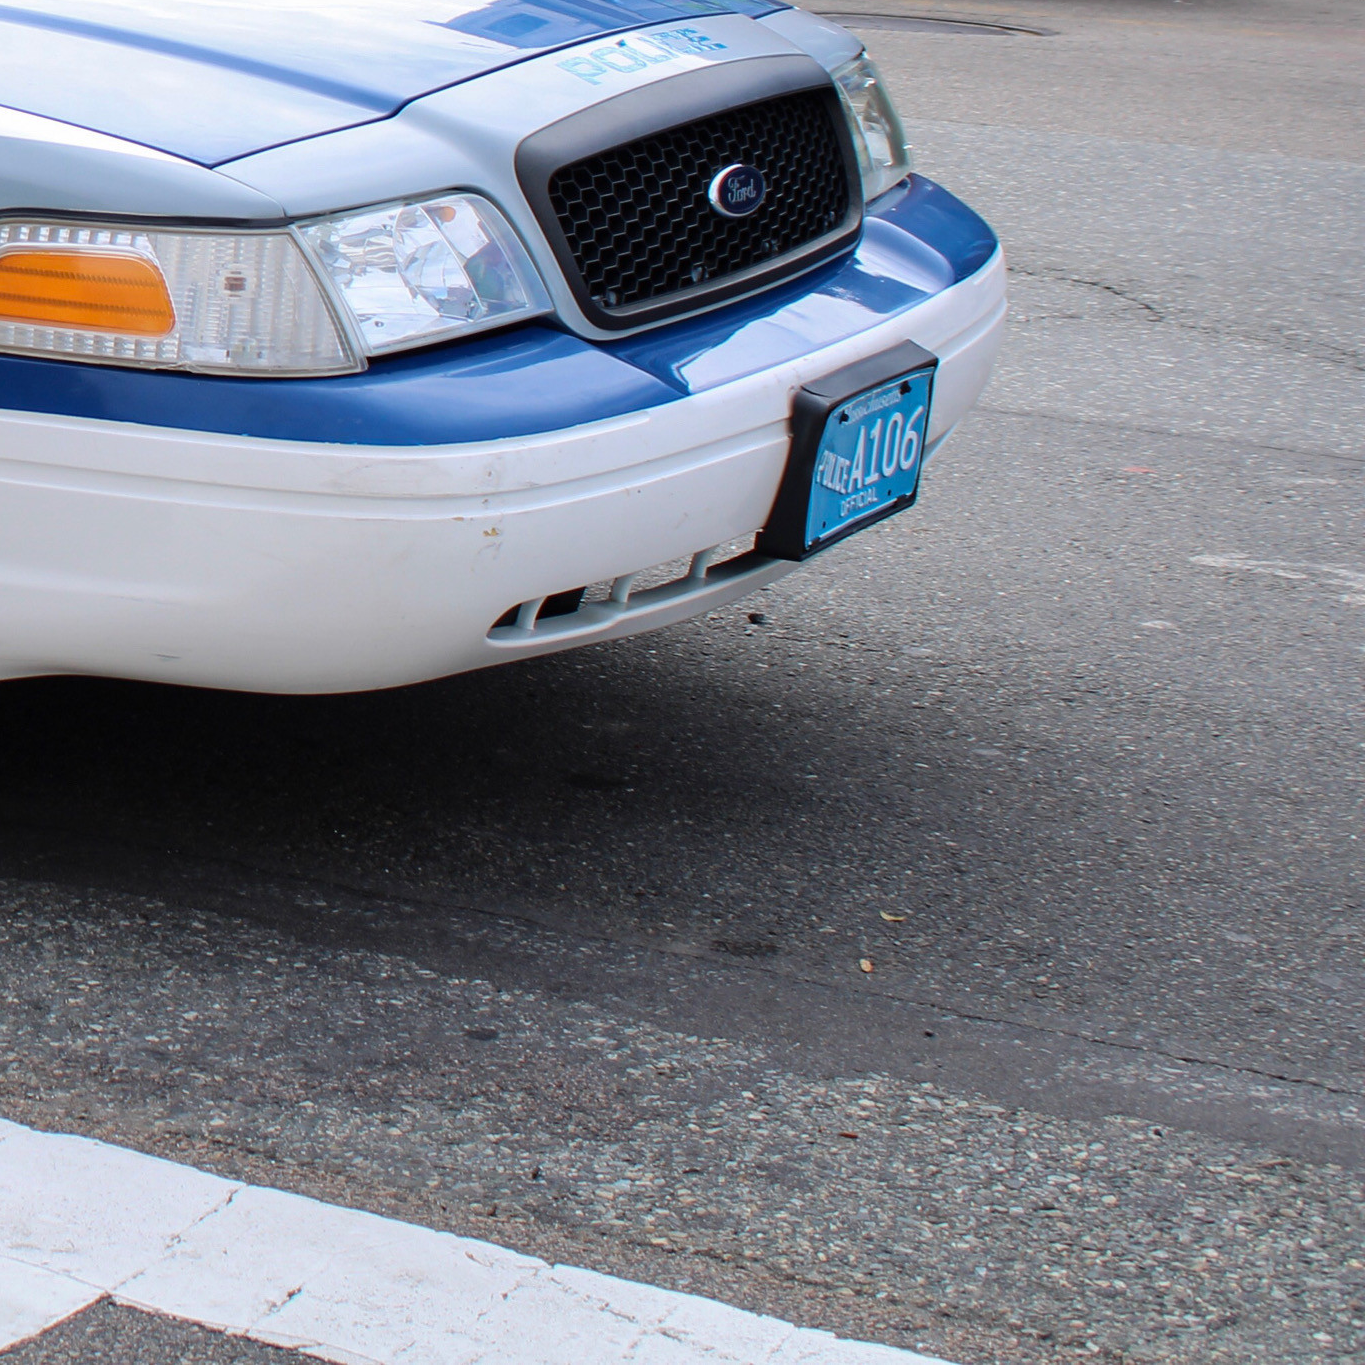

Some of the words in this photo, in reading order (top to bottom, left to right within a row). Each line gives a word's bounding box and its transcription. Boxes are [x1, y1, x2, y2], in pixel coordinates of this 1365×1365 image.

[727, 175, 757, 204] Ford
[848, 405, 924, 493] A106
[840, 486, 878, 517] OFFICIAL
